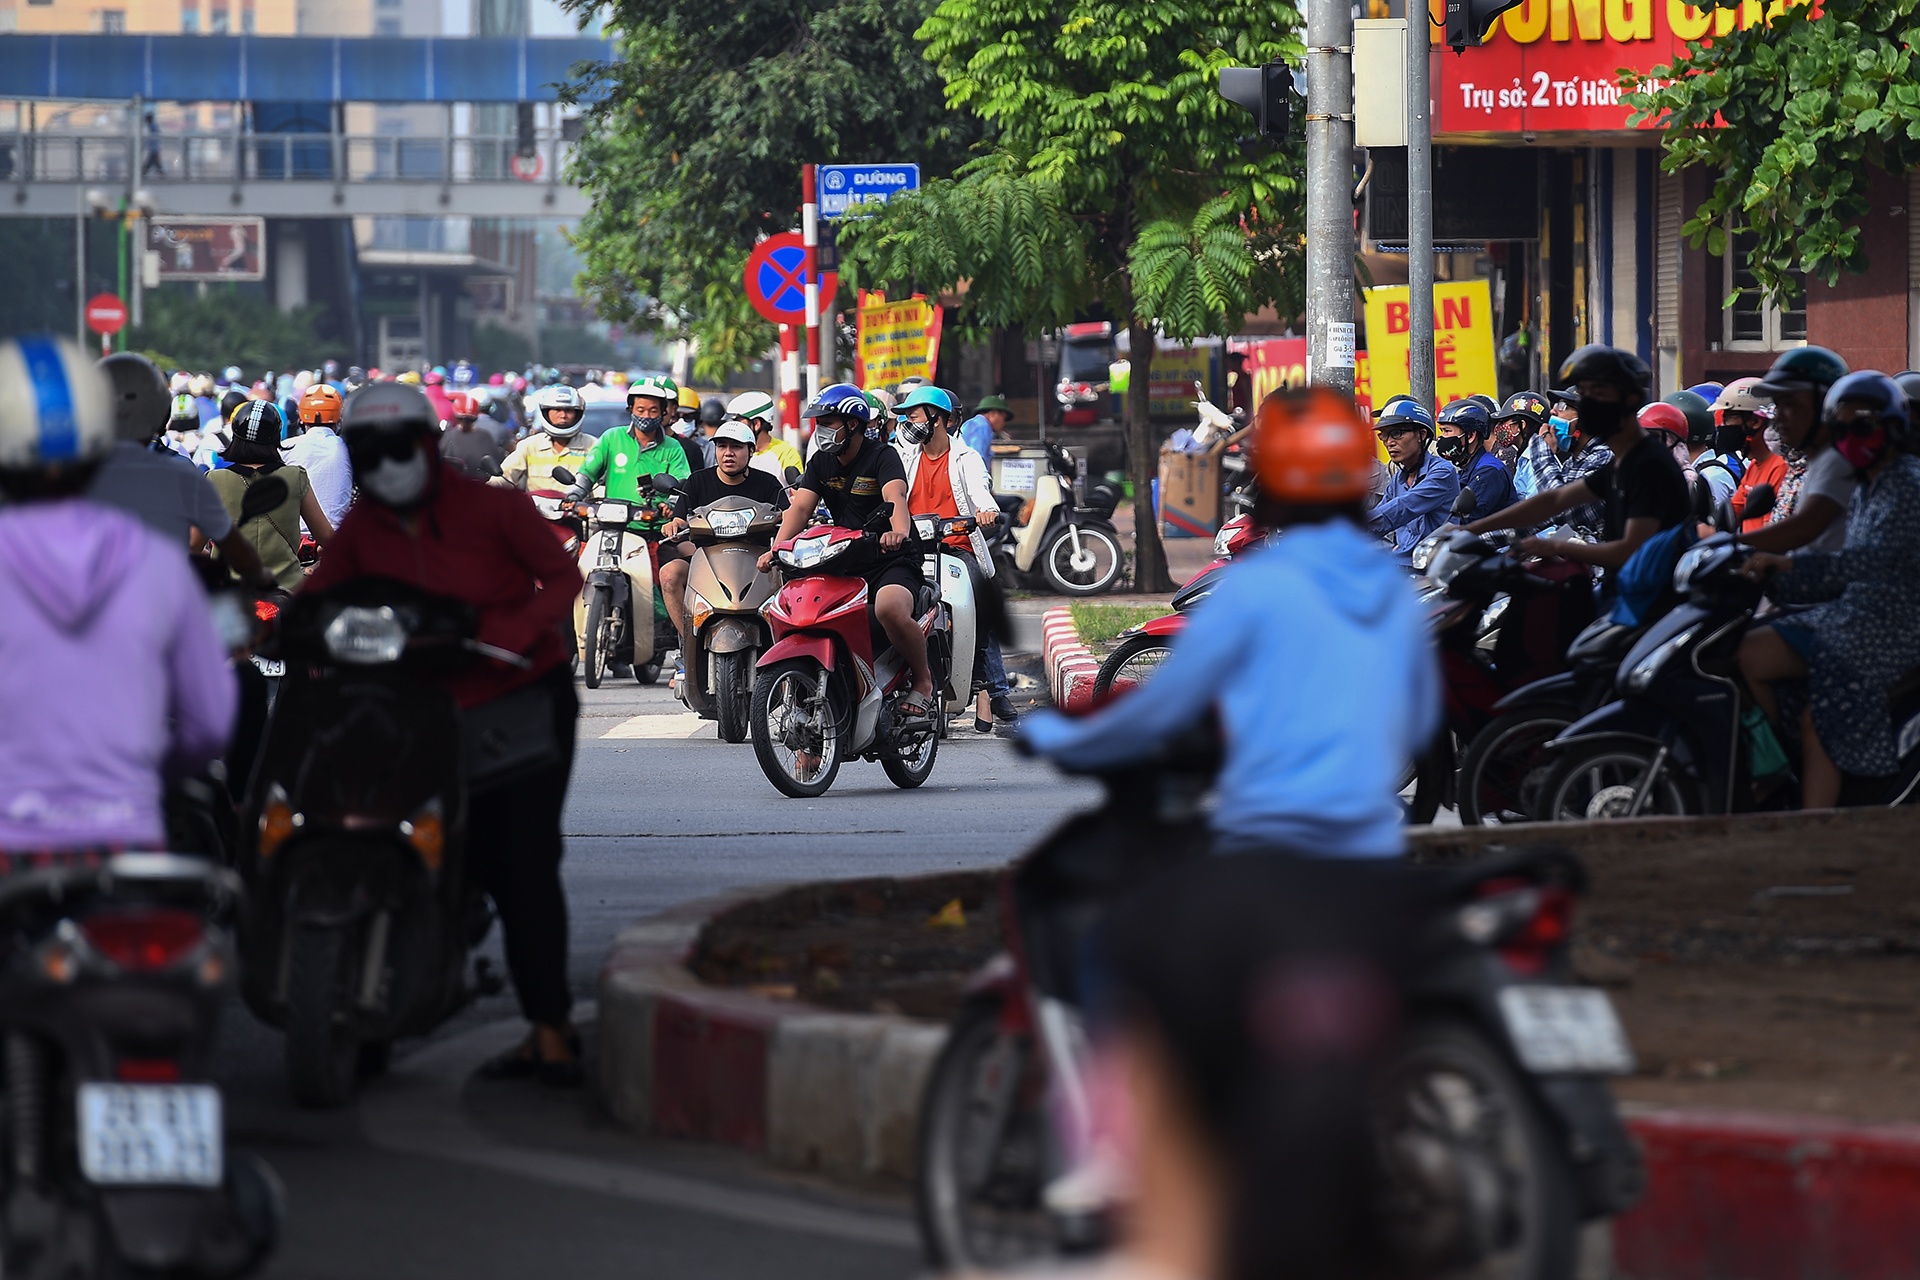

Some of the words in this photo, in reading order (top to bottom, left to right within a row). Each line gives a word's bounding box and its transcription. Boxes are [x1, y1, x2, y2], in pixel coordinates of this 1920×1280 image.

[1459, 83, 1494, 115] Trụ
[1531, 71, 1550, 108] 2
[1552, 76, 1578, 106] Tố
[1581, 79, 1622, 106] Hữu
[1386, 296, 1471, 334] BN
